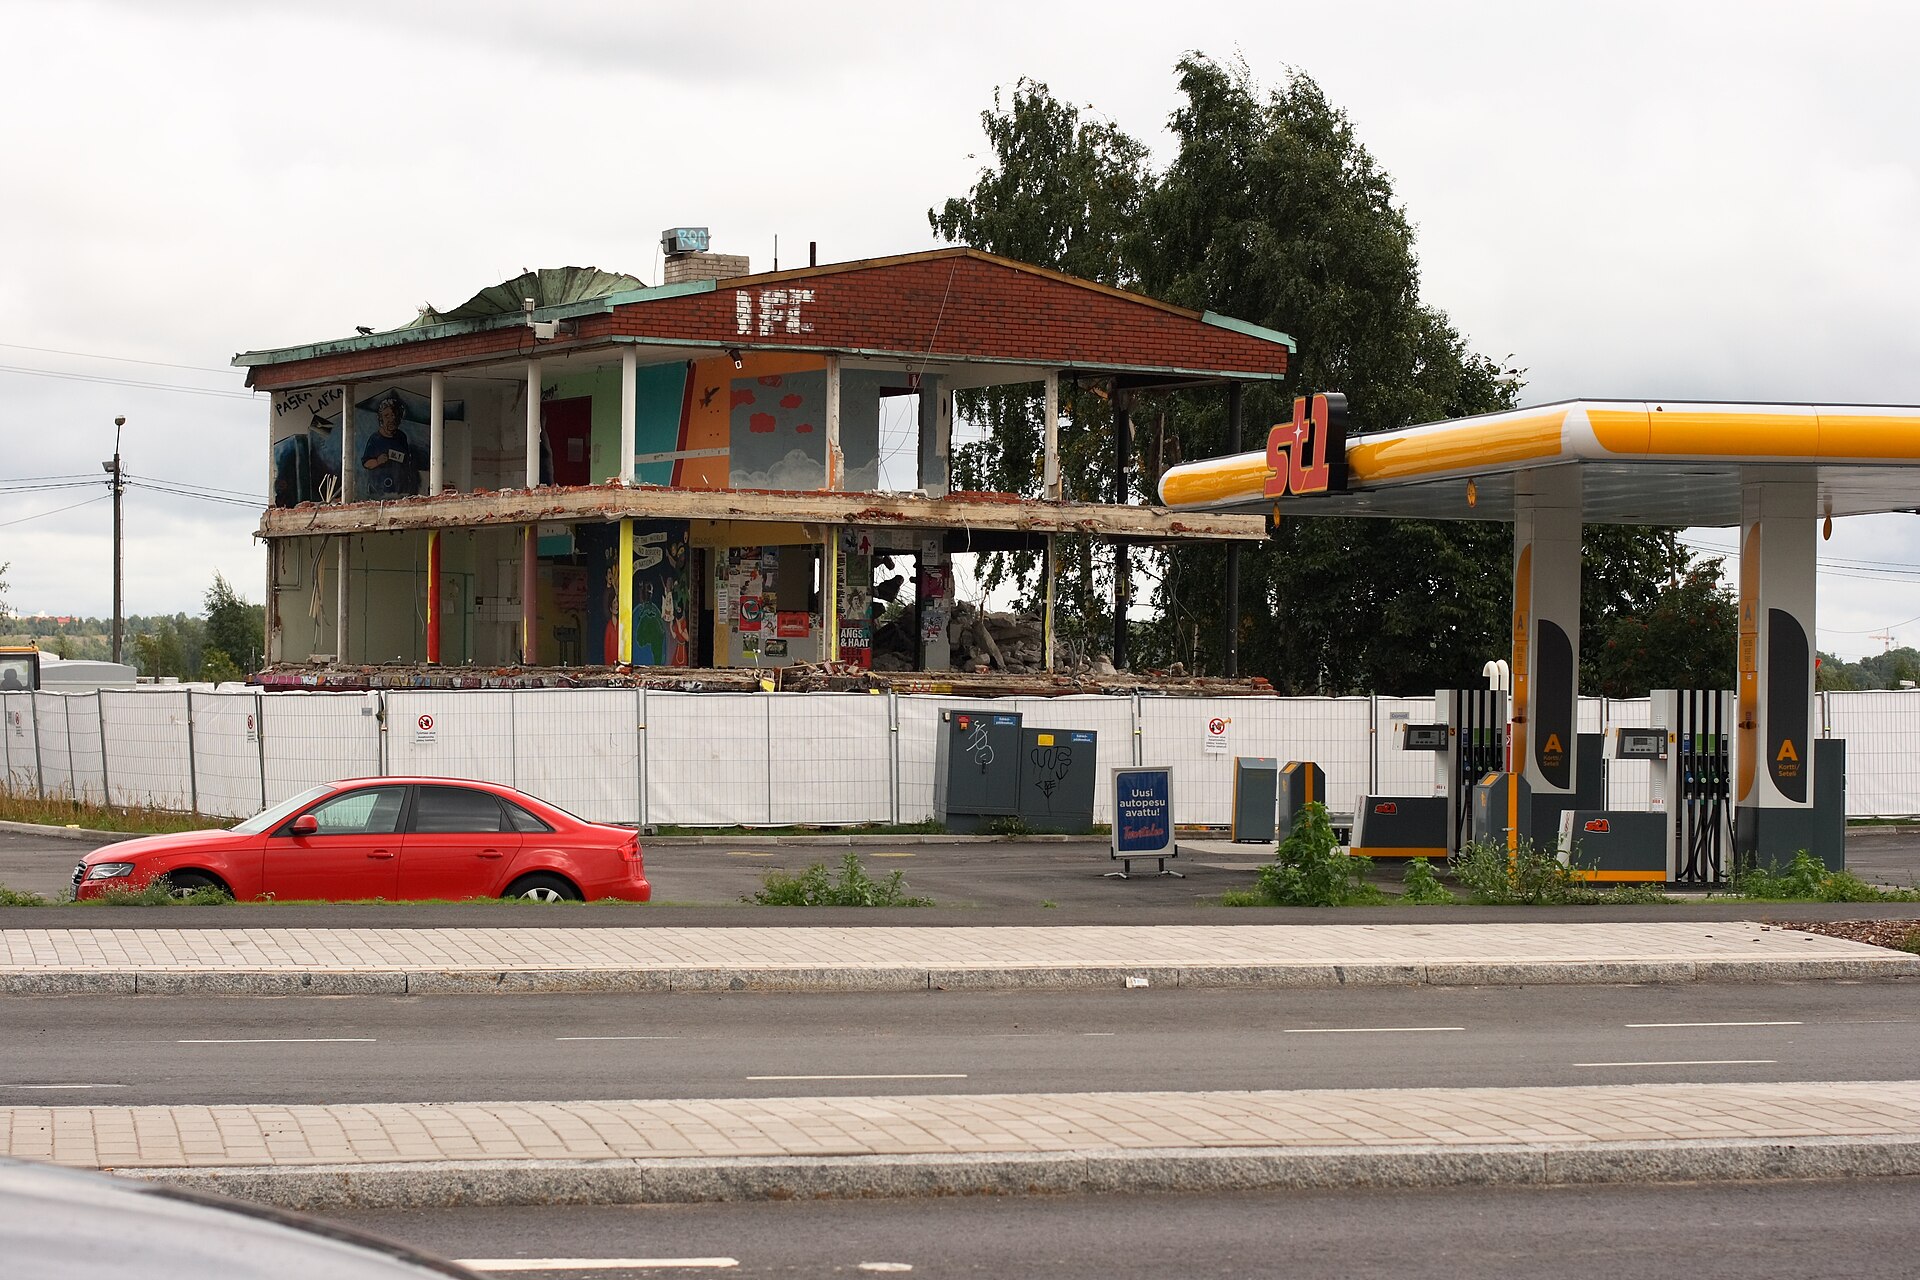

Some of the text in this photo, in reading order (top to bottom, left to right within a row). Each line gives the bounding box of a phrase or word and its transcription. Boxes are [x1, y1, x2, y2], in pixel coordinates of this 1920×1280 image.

[840, 629, 865, 638] ANGS
[840, 638, 870, 647] & HAAT
[1449, 728, 1456, 736] 3
[1669, 734, 1674, 742] 1
[1543, 733, 1563, 753] A
[1776, 739, 1798, 761] A
[1131, 788, 1153, 798] Uusi
[1119, 799, 1166, 808] autopesu
[1125, 808, 1160, 817] avattu!
